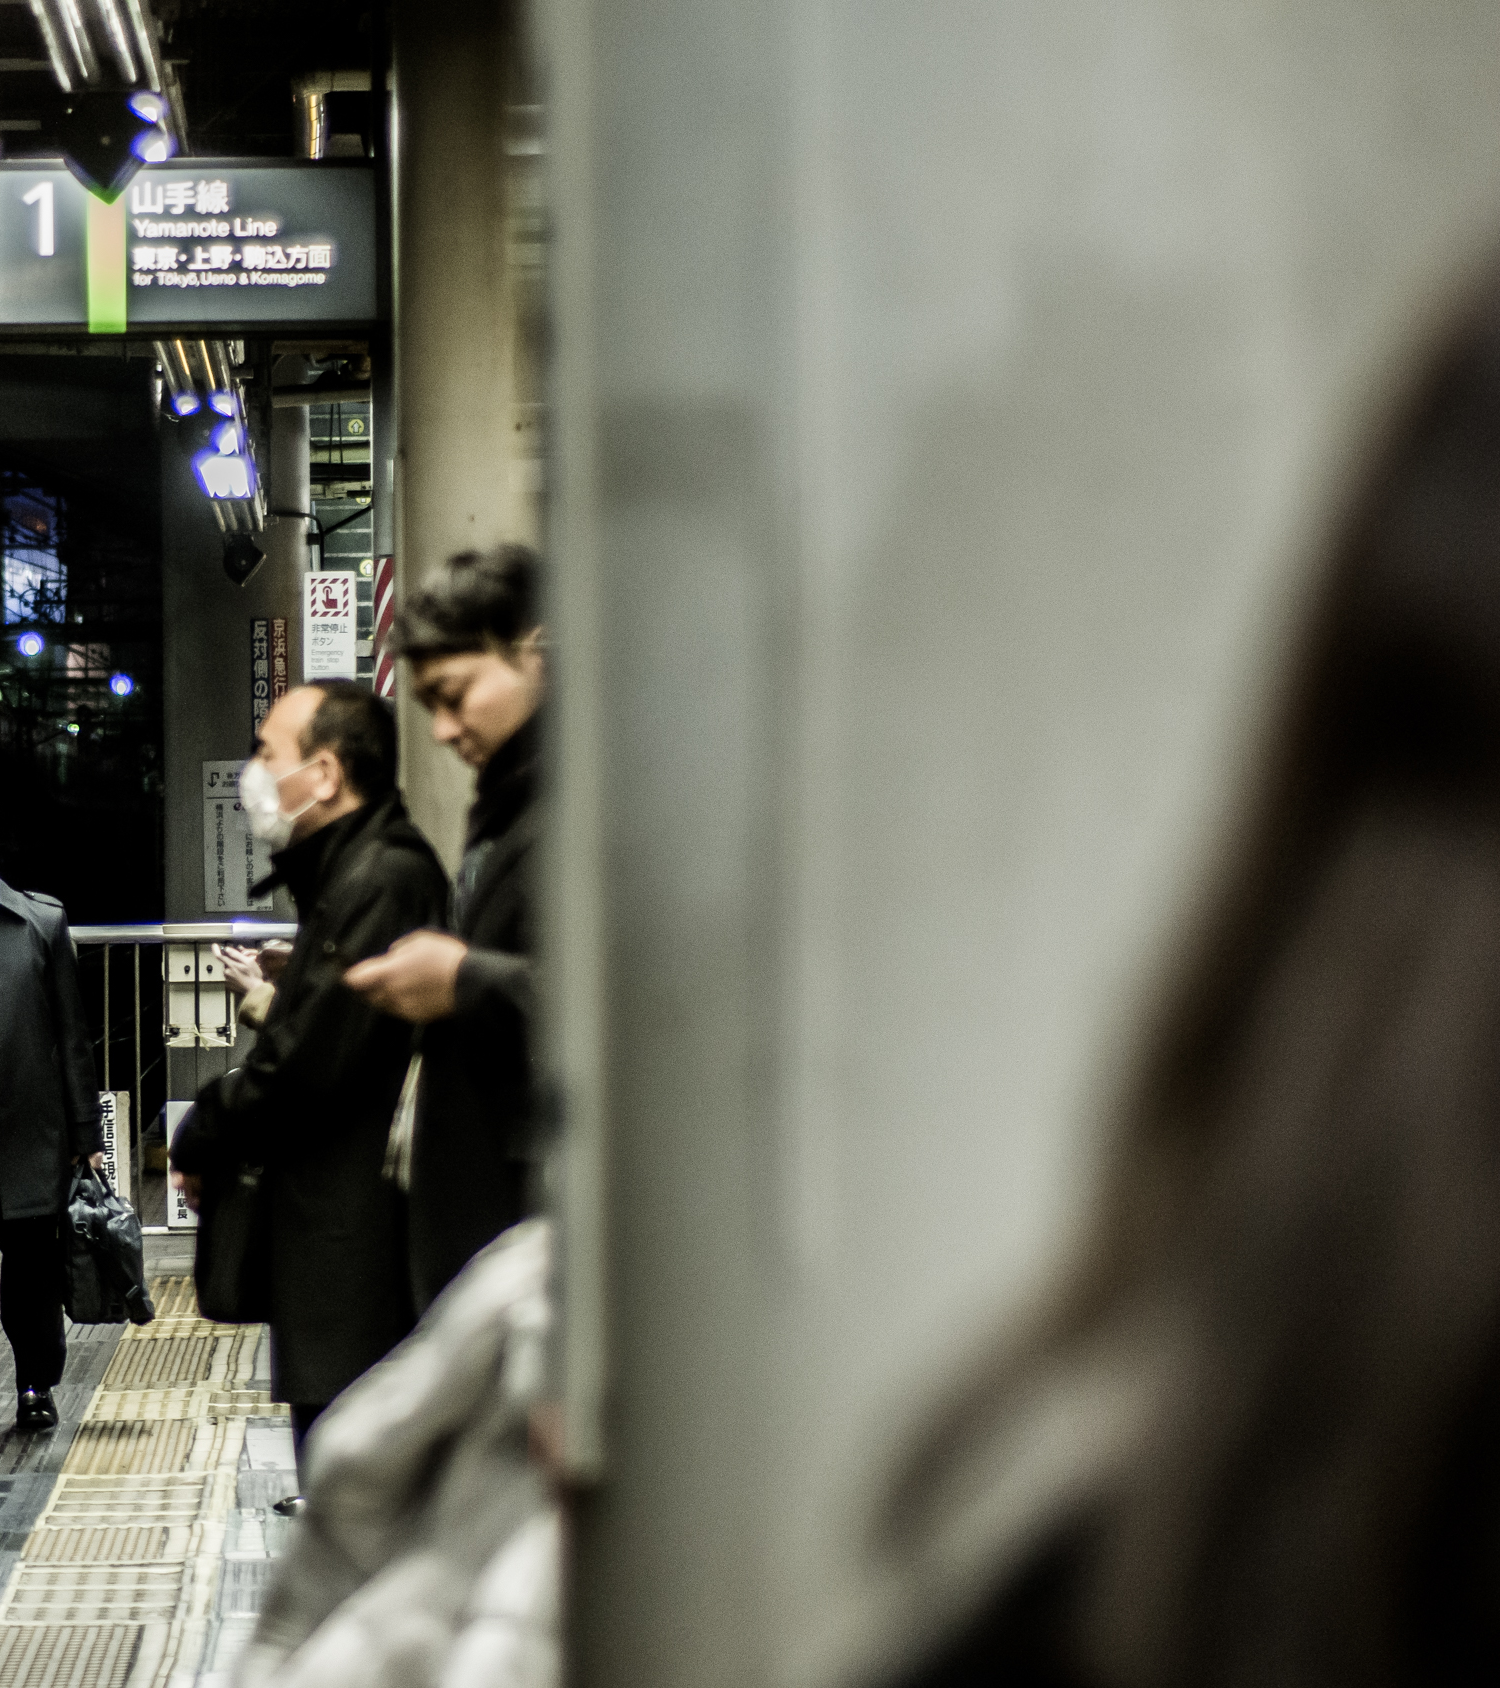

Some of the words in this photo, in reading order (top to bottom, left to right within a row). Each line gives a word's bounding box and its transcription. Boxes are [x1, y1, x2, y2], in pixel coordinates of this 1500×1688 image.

[131, 180, 229, 215] 山手線
[23, 181, 54, 257] 1
[132, 218, 231, 239] Yamanote
[233, 217, 278, 238] Line
[132, 272, 153, 287] for
[238, 273, 249, 285] &
[250, 271, 327, 288] Komagome
[311, 623, 348, 634] 非常停止
[311, 637, 334, 647] ボタン
[311, 649, 344, 657] Emergency
